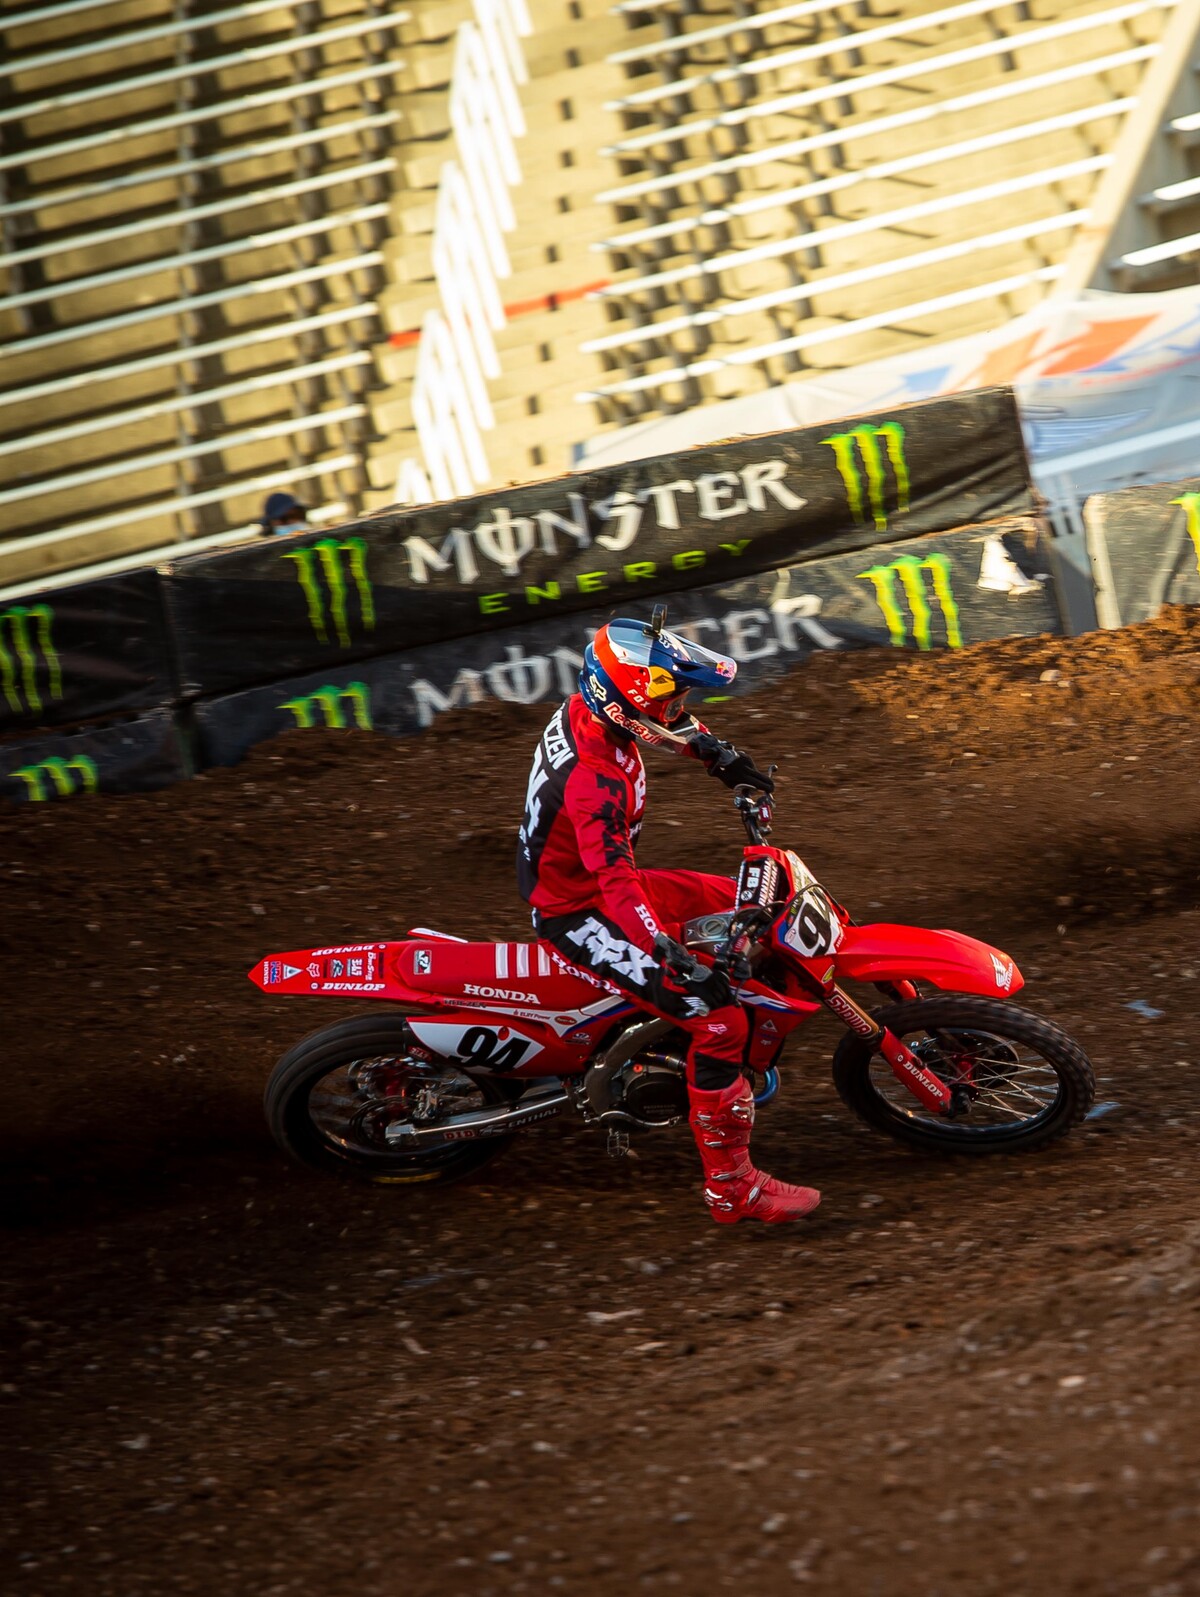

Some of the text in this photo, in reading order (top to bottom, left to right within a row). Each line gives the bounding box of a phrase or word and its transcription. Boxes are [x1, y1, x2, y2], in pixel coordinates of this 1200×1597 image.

[403, 460, 807, 585] MONSTER
[479, 539, 753, 615] ENERGY
[408, 594, 844, 728] MONTER
[603, 702, 637, 732] Red
[627, 688, 651, 708] FOX
[321, 982, 386, 991] DUNLOP
[463, 983, 541, 1004] HONDA
[551, 952, 622, 995] HONDA
[1004, 962, 1014, 991] HONDA
[828, 994, 872, 1036] SHOWA
[448, 1026, 532, 1073] 94
[902, 1060, 944, 1098] DUNLOP
